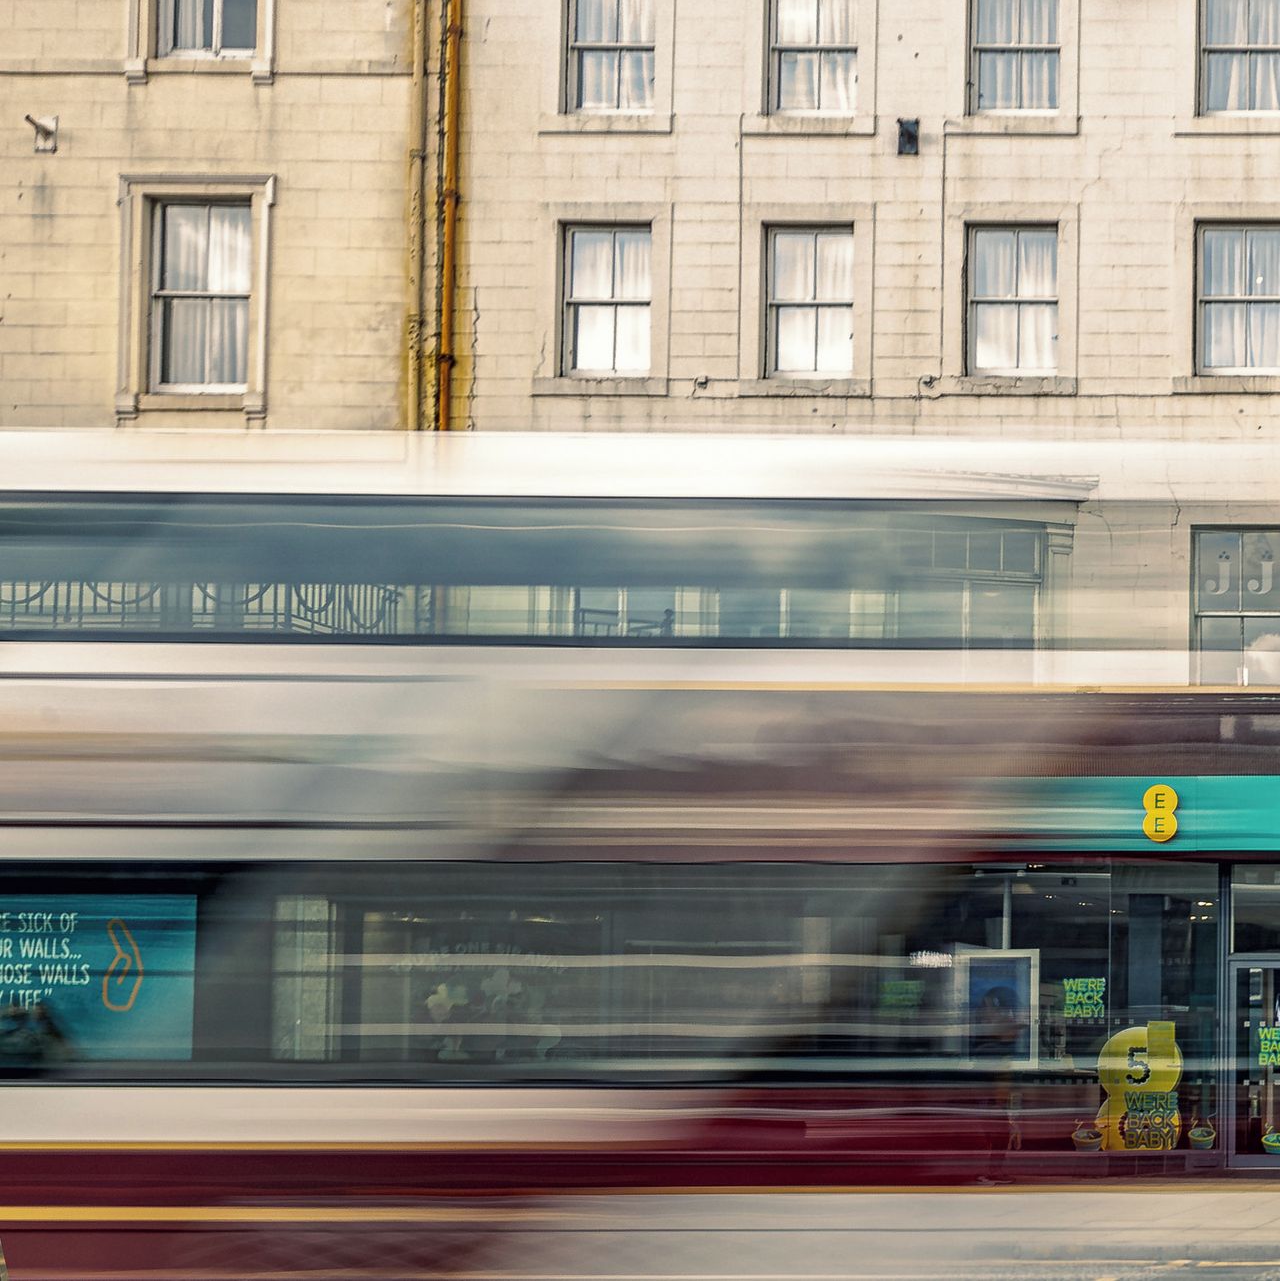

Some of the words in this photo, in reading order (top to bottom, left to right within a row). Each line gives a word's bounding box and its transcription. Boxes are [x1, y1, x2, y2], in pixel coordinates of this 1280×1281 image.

[18, 912, 52, 933] SICK
[60, 912, 79, 933] OF
[39, 964, 91, 985] WALLS
[1065, 991, 1104, 1004] BACK
[1126, 1045, 1152, 1087] 5
[1128, 1110, 1177, 1130] BACK
